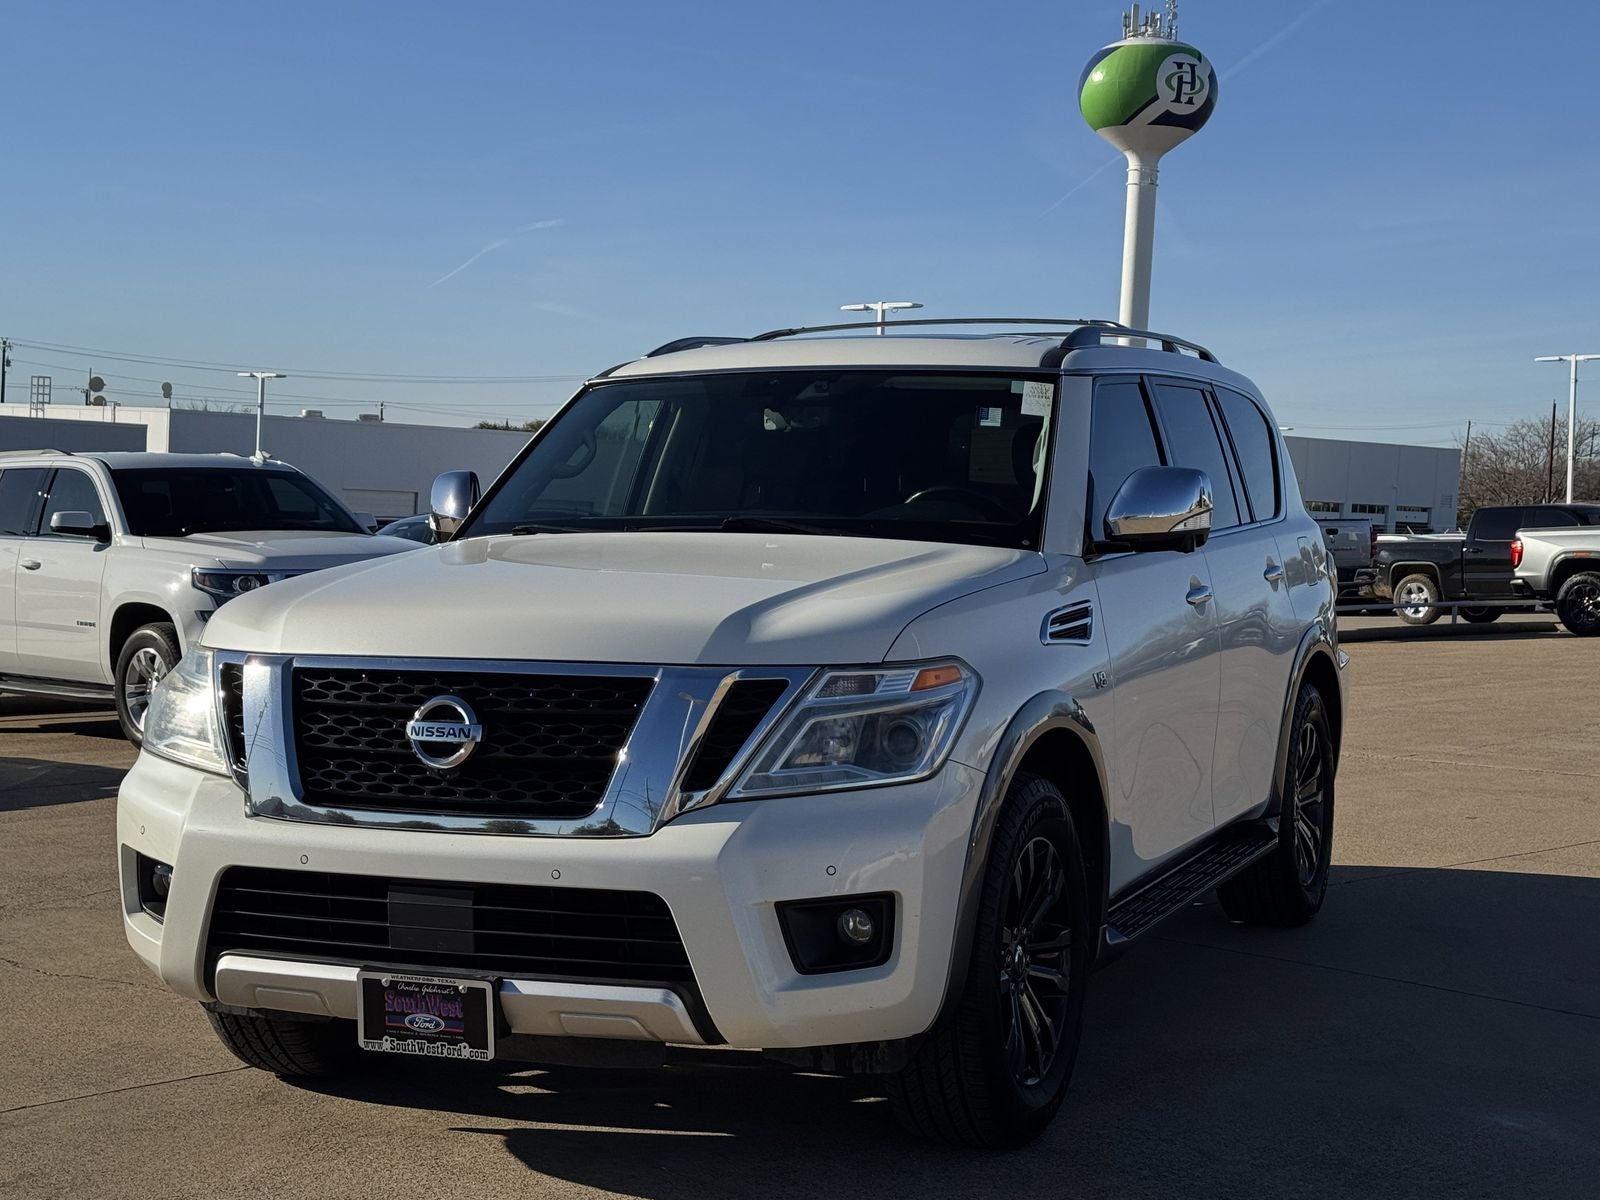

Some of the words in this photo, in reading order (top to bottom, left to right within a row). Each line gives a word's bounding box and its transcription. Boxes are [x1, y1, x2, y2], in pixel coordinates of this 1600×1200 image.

[1092, 671, 1107, 689] V8
[410, 725, 472, 739] NISSAN
[413, 1016, 436, 1029] Ford
[363, 1039, 489, 1060] www.SouthWestFord.com
